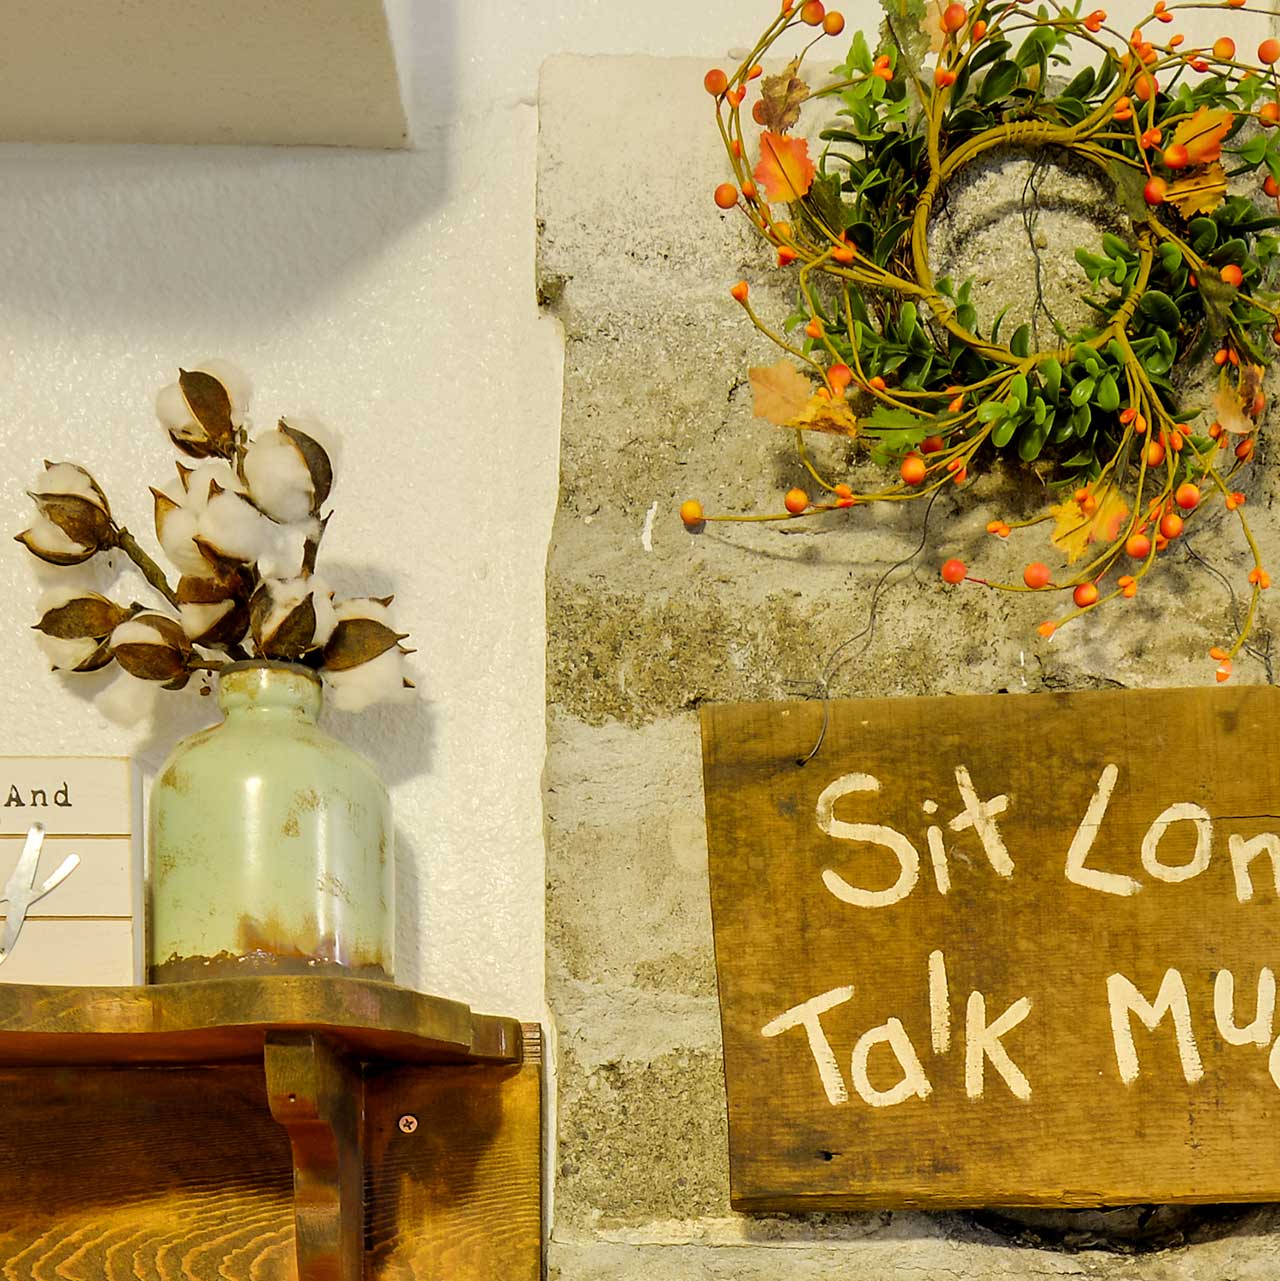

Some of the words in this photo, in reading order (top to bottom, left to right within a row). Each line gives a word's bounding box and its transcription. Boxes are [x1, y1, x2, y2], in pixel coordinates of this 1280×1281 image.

[3, 783, 73, 808] And
[816, 764, 1015, 907] Sit
[761, 949, 1033, 1107] Talk
